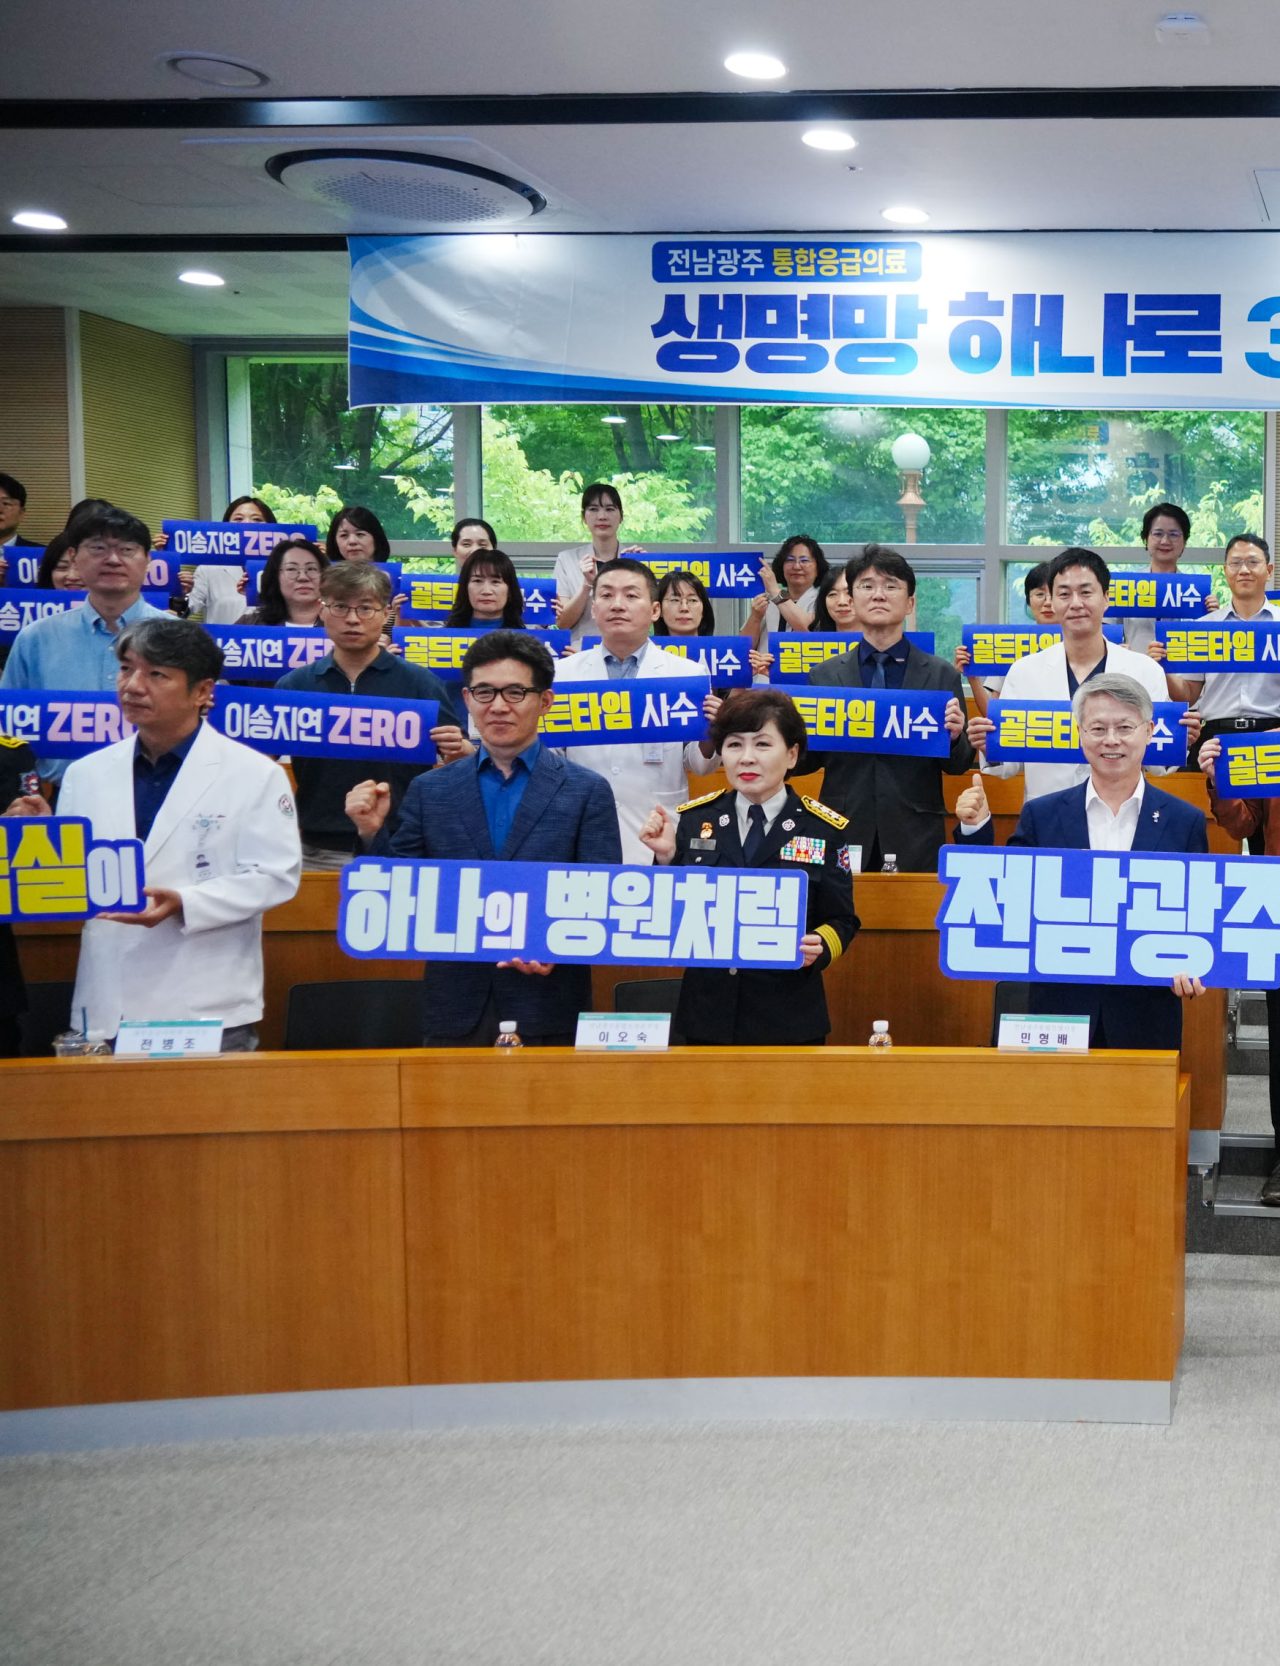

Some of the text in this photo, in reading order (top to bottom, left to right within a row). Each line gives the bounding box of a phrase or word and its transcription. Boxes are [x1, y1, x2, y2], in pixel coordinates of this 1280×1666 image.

[667, 249, 908, 276] 전남광주 통합응급의료
[651, 293, 927, 375] 생명망
[174, 530, 306, 556] 이송지연 ZE
[716, 563, 755, 587] 사수
[411, 581, 459, 610] 골든
[1108, 580, 1202, 608] 타임 사수
[216, 637, 334, 668] 송지연 ZE
[779, 641, 861, 674] 골든
[1166, 631, 1255, 662] 골든타임
[47, 702, 137, 744] ZER
[225, 702, 421, 748] 이송지연 ZERO
[537, 691, 698, 733] 든타임 사수
[791, 697, 939, 740] 든타임 사수
[999, 710, 1080, 749] 골든타
[345, 864, 801, 962] 하나의 병원처럼
